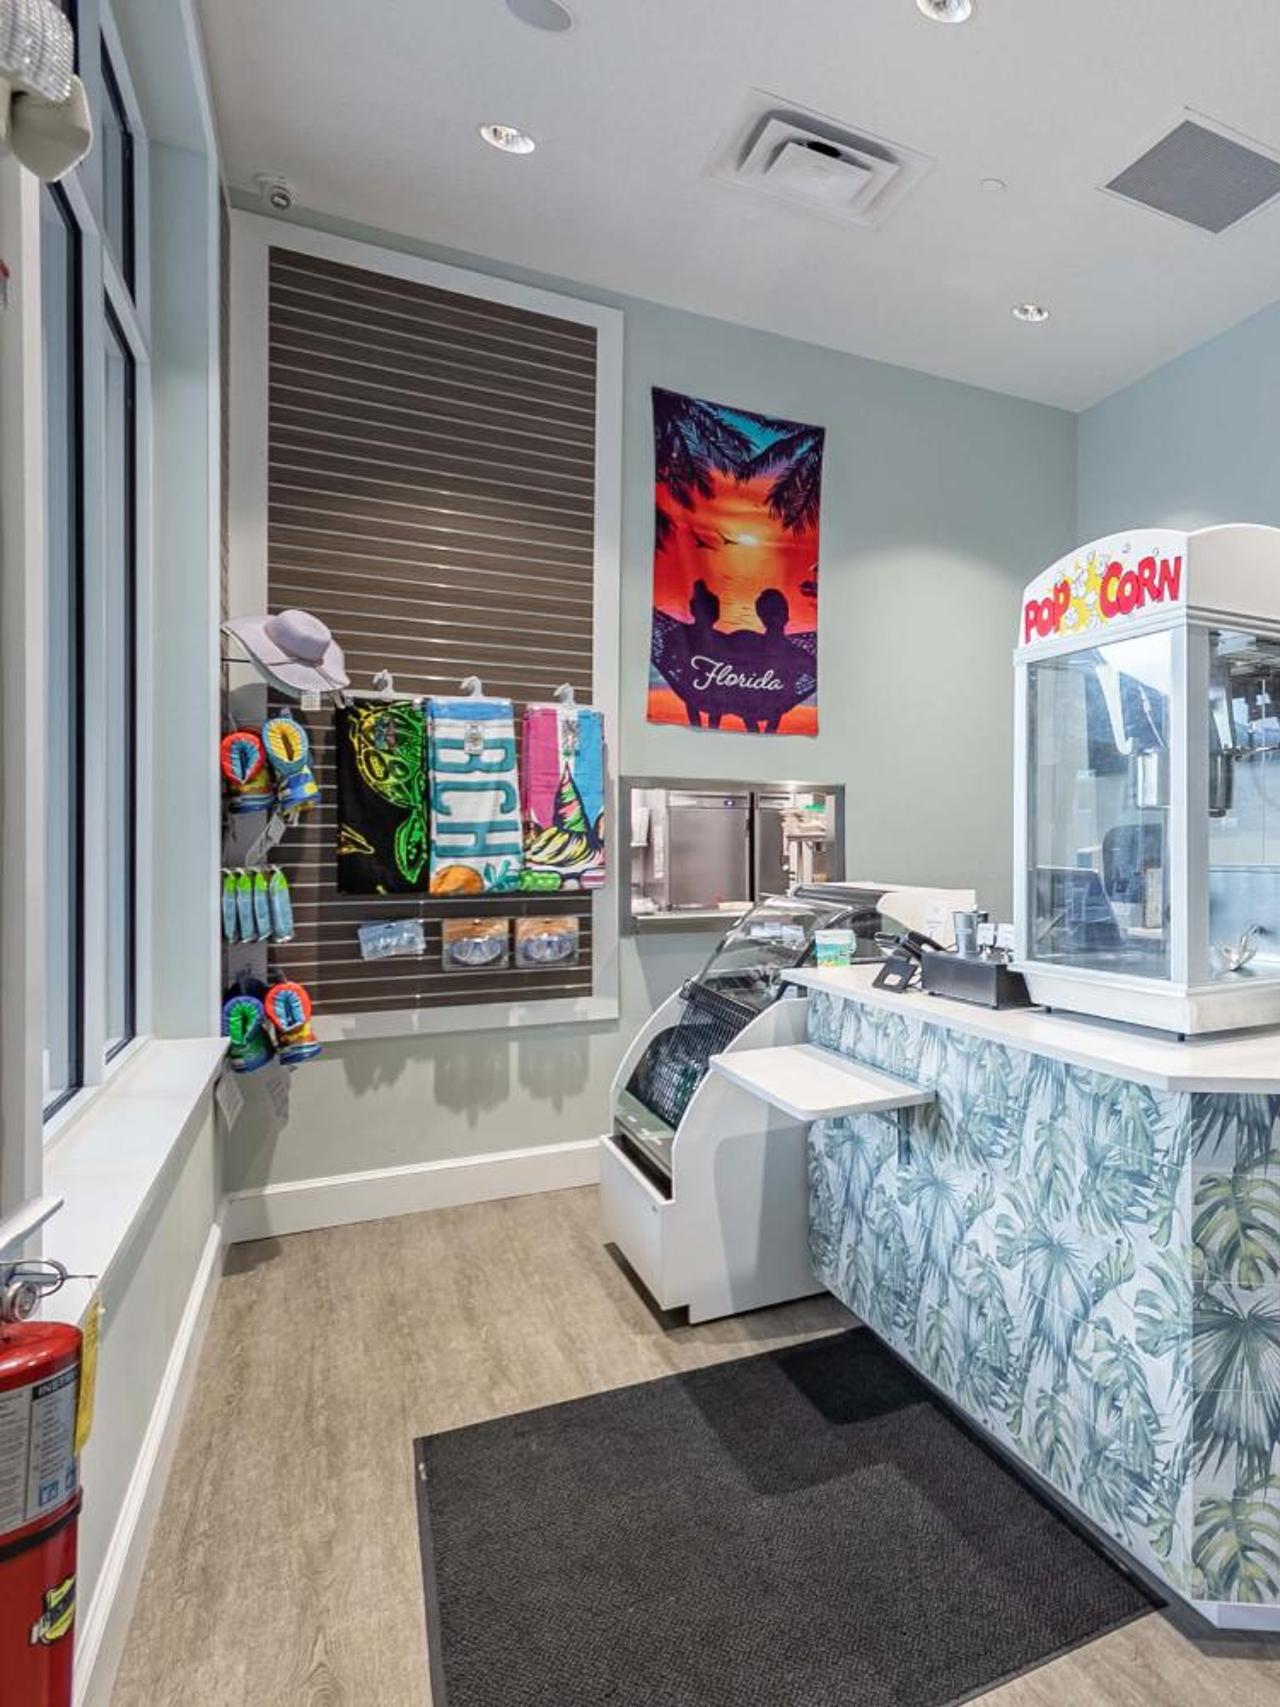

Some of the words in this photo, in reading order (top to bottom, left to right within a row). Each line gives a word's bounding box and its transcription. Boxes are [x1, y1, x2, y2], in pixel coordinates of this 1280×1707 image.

[1025, 579, 1071, 645] POP
[1100, 556, 1182, 618] CORN
[690, 655, 784, 690] Florida
